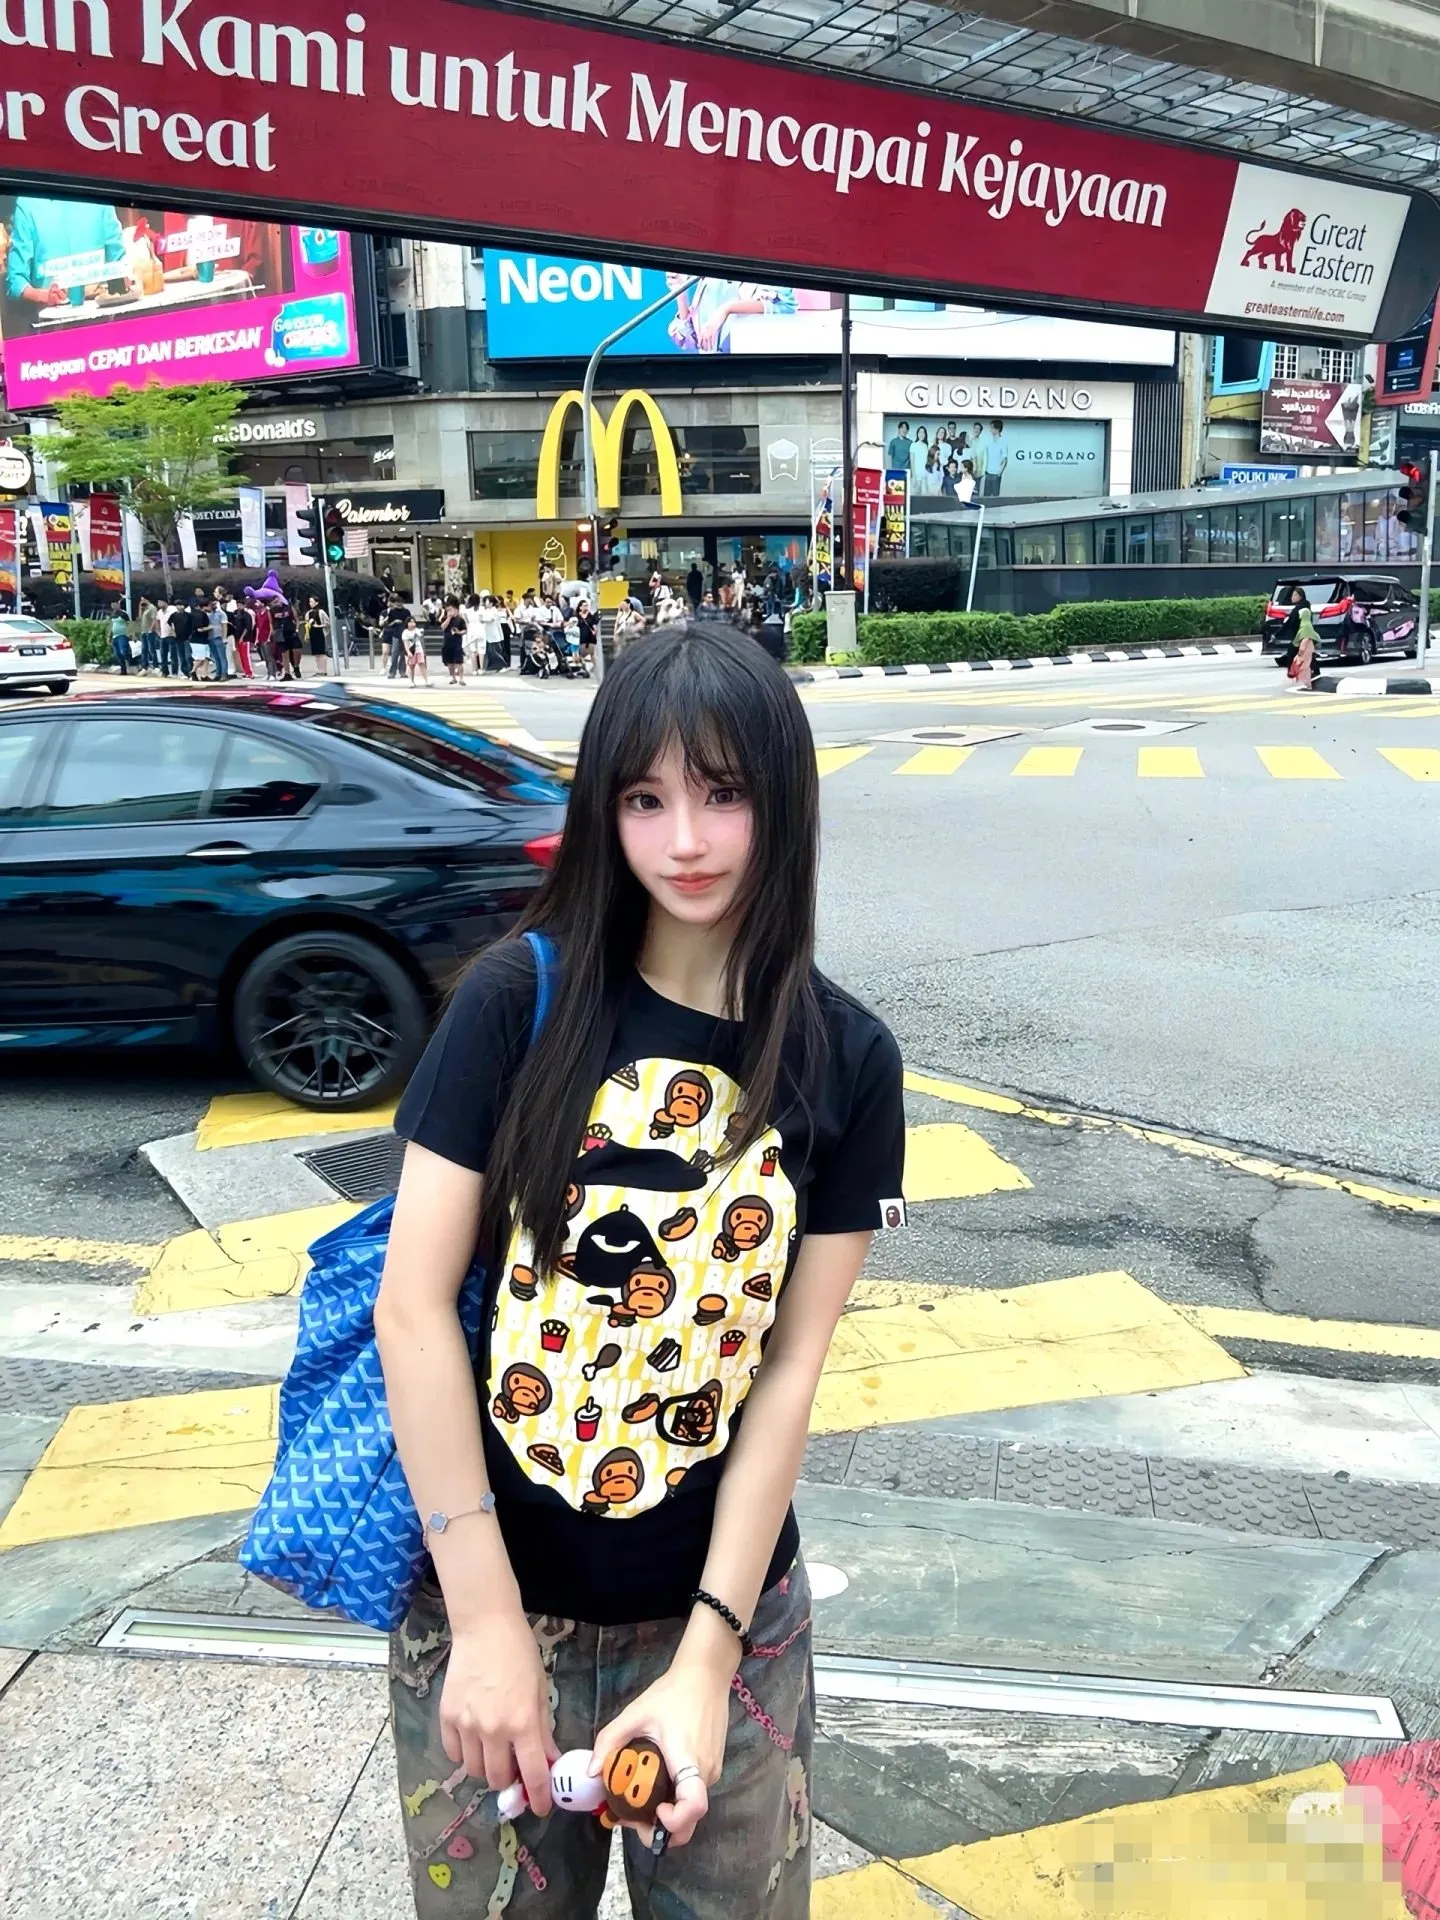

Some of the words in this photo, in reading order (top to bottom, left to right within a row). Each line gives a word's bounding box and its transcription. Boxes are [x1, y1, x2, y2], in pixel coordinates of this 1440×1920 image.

[0, 91, 46, 141] r
[64, 84, 277, 173] Great
[142, 0, 367, 97] Kami
[389, 46, 612, 138] untuk
[626, 72, 931, 194] Mencapai
[938, 131, 1168, 228] Kejayaan
[1309, 213, 1367, 251] Great
[498, 257, 644, 305] NeoN
[1299, 246, 1374, 286] Eastern
[1277, 282, 1306, 293] member
[1306, 285, 1315, 294] of
[1315, 286, 1327, 296] the
[1244, 301, 1345, 323] greateasternlife.com
[20, 357, 86, 383] Kelegaan
[88, 344, 136, 372] CEPAT
[137, 340, 172, 365] DAN
[904, 381, 1094, 411] GIORDANO
[1015, 449, 1096, 461] GIORDANO
